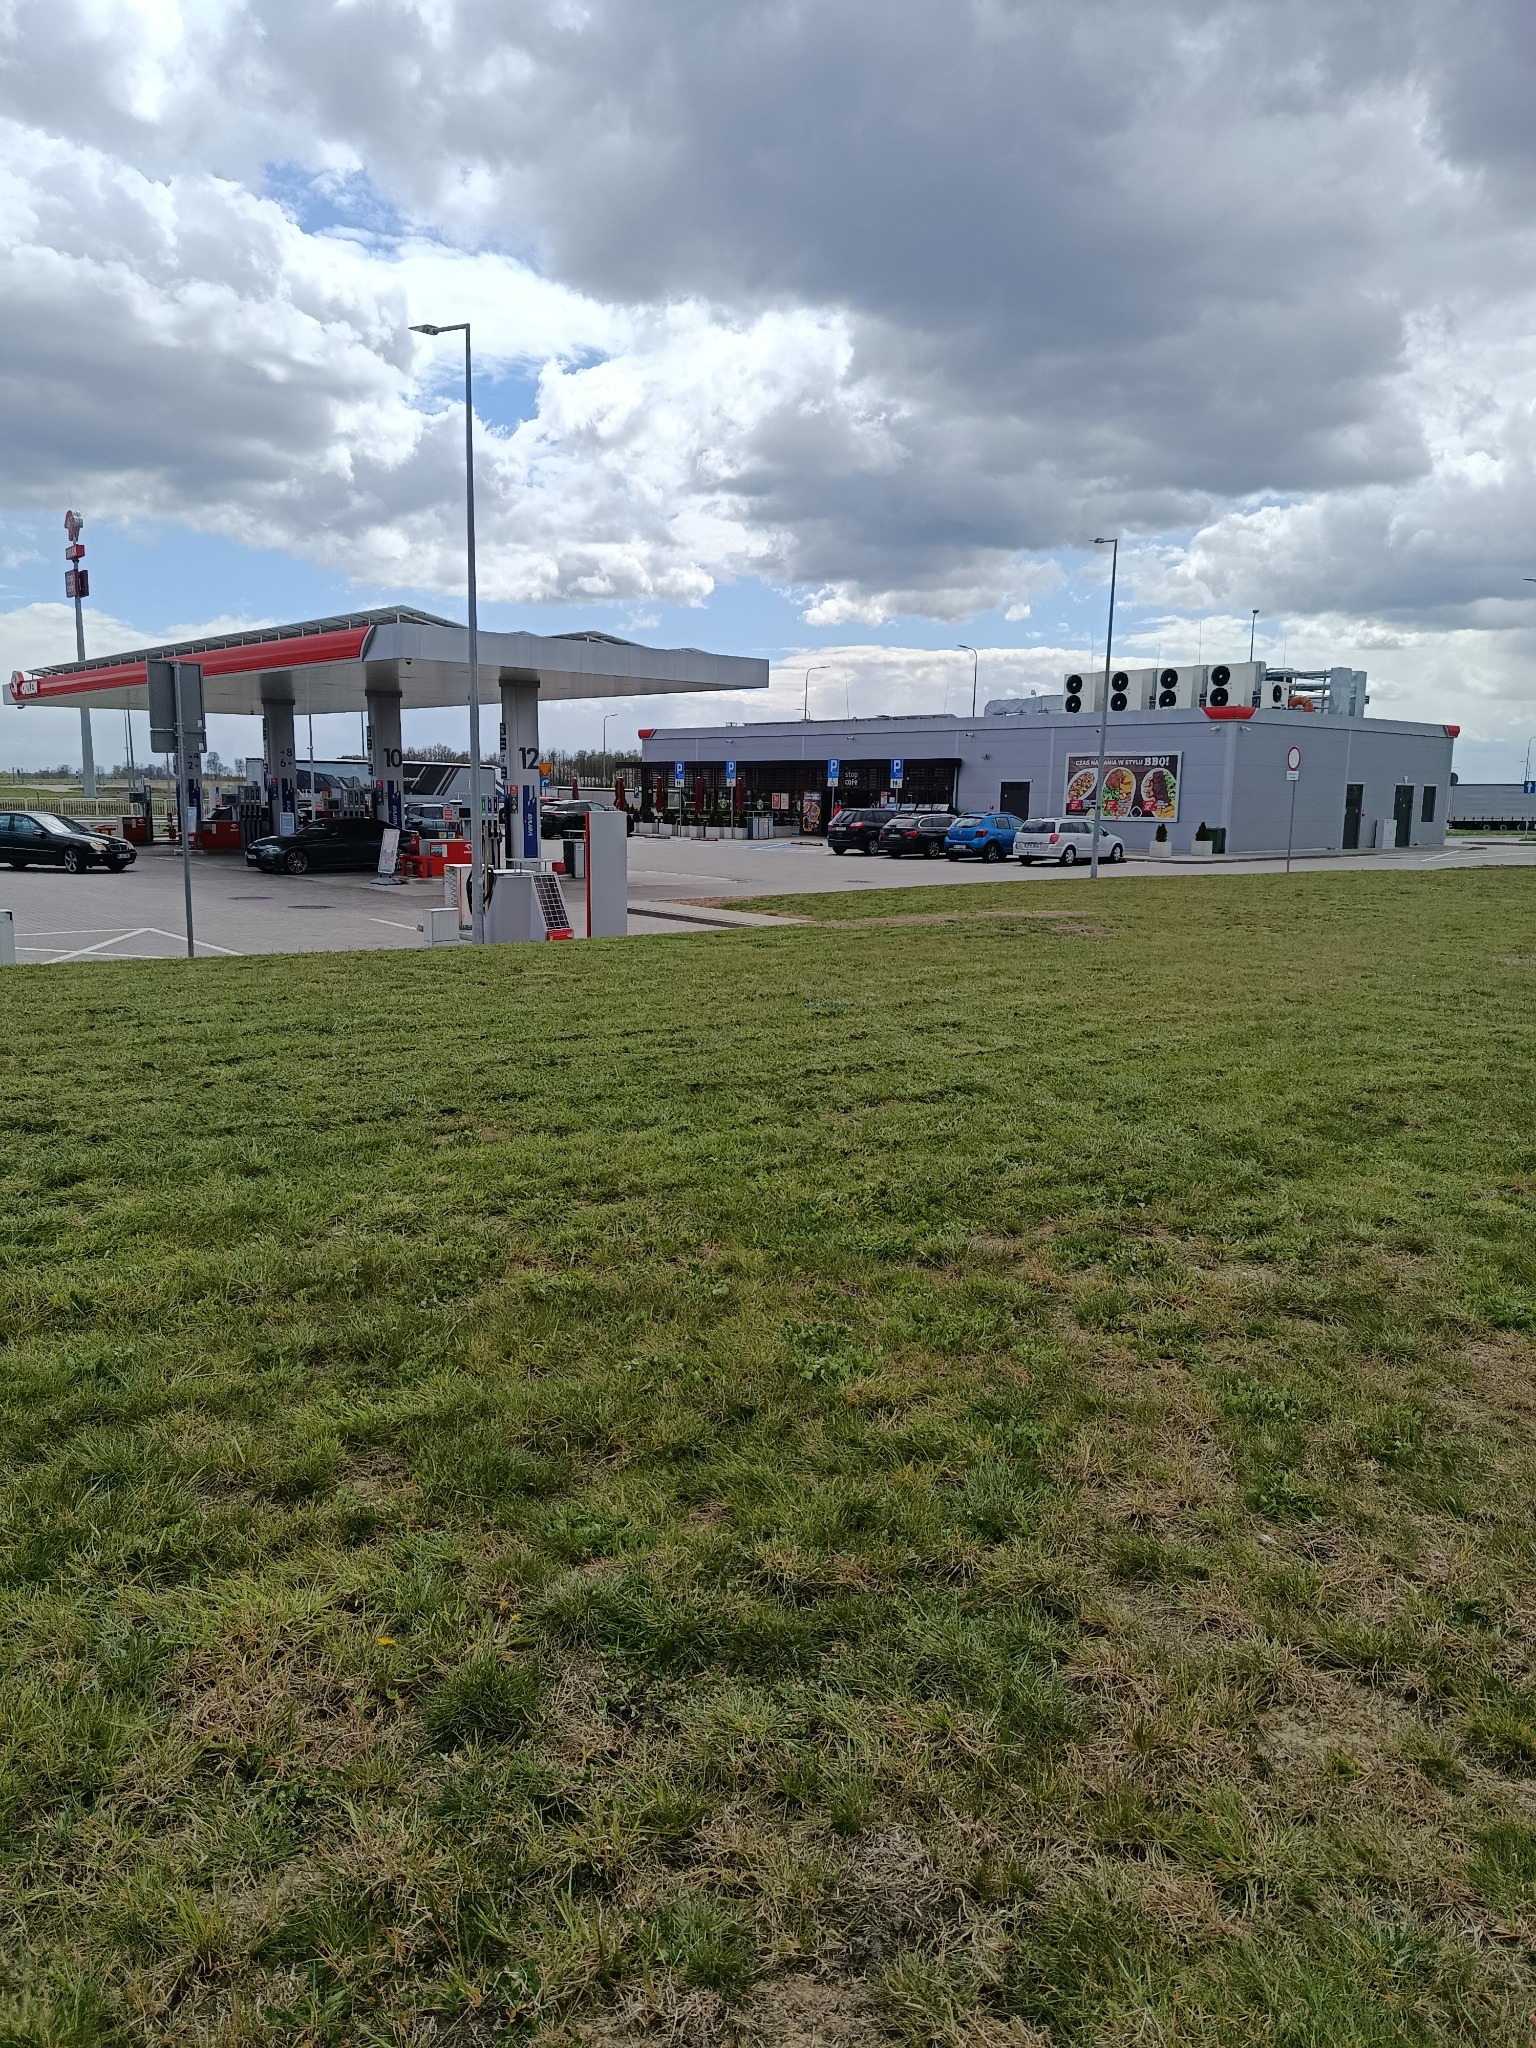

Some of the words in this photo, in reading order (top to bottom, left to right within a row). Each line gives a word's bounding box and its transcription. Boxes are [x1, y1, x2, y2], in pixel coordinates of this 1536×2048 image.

[286, 748, 293, 757] 8
[383, 747, 402, 767] 10
[519, 747, 539, 769] 12
[187, 761, 194, 770] 2
[281, 759, 287, 768] 6
[728, 761, 735, 774] P
[830, 759, 838, 773] P
[893, 759, 901, 773] P
[1144, 757, 1169, 766] BBQ!
[676, 763, 683, 775] P
[844, 771, 859, 779] stop
